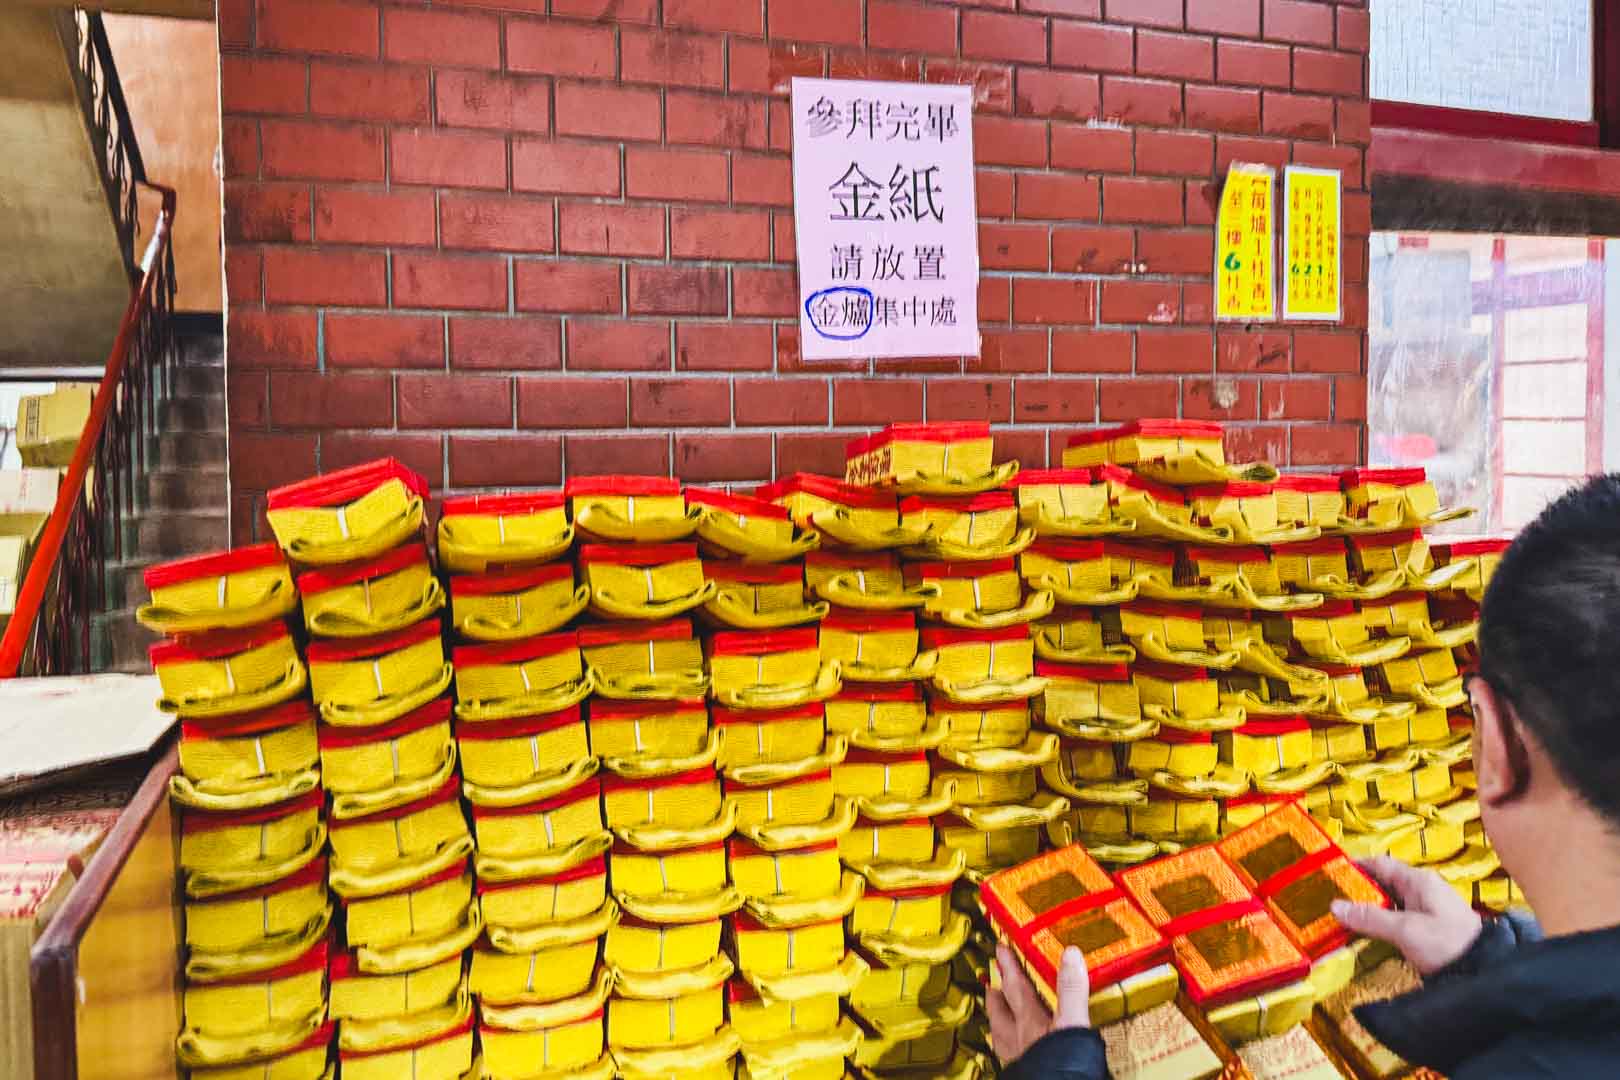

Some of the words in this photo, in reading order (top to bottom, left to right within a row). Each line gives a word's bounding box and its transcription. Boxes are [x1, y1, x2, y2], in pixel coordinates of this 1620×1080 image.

[805, 95, 960, 144] 參拜完畢
[828, 160, 945, 224] 金紙
[830, 243, 947, 281] 請放置
[812, 295, 958, 328] 金爐集中處
